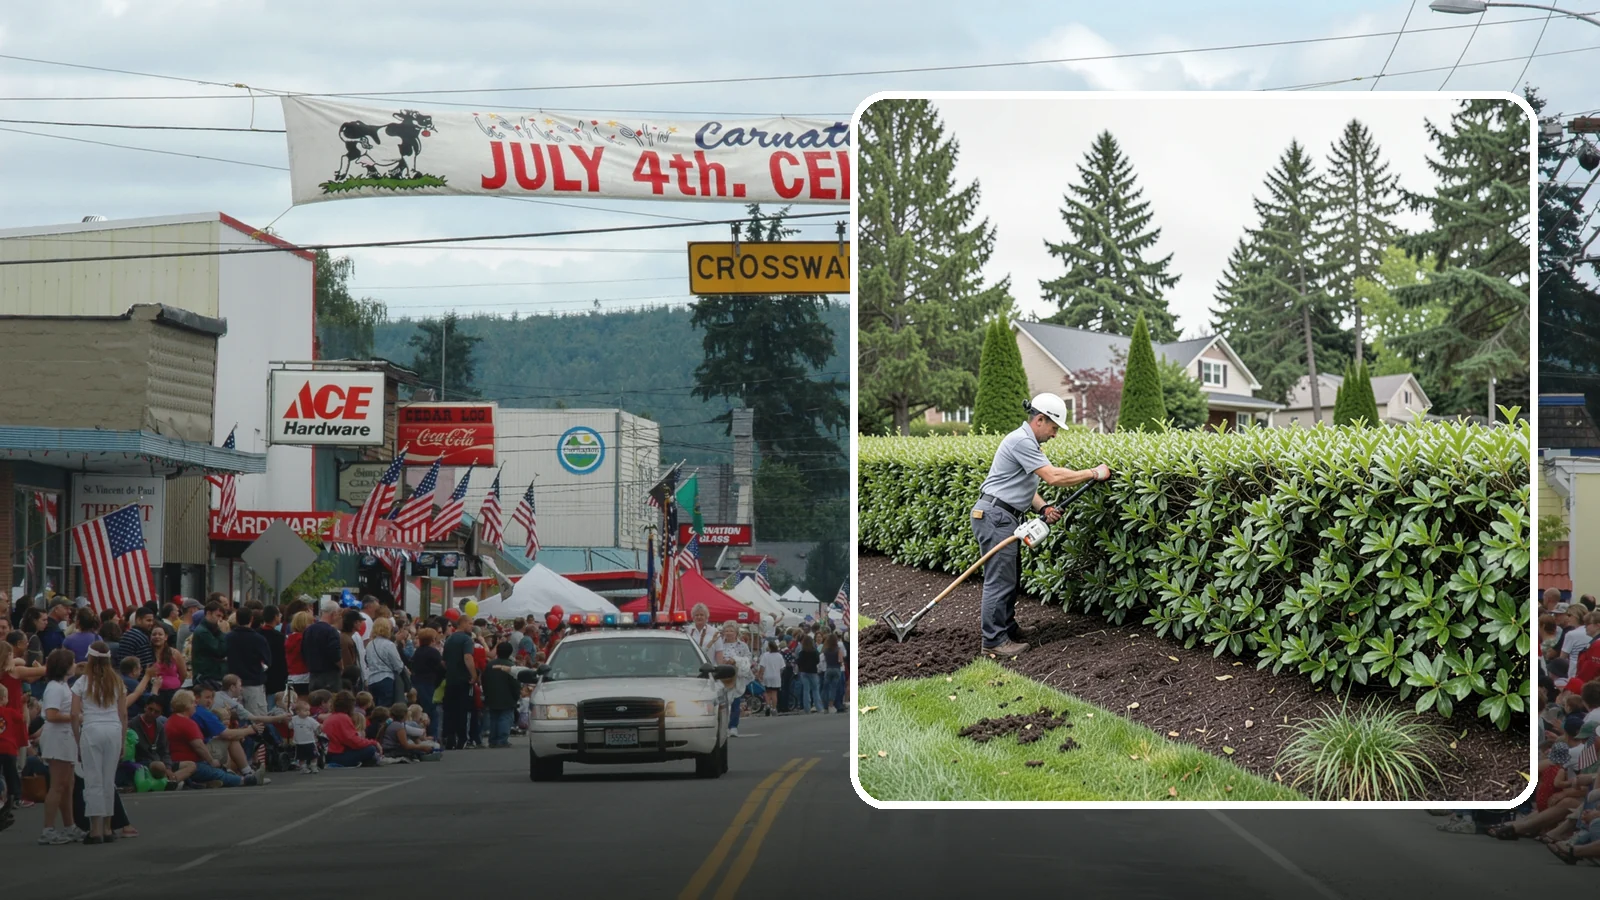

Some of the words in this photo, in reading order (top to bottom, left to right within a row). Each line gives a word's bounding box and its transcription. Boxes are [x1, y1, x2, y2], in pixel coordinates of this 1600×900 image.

[695, 121, 850, 149] Carnat
[481, 141, 605, 193] JULY
[632, 149, 746, 198] 4th.
[697, 254, 850, 280] CROSSWA
[283, 380, 373, 420] ACE
[405, 409, 453, 422] CEDAR
[283, 421, 371, 436] Hardware
[416, 428, 477, 447] Coca-Cola
[353, 467, 385, 480] Simpl
[95, 485, 124, 495] Vincent
[126, 486, 136, 495] de
[138, 486, 155, 495] Paul
[688, 526, 741, 535] CRNATION
[699, 535, 730, 543] GLASS
